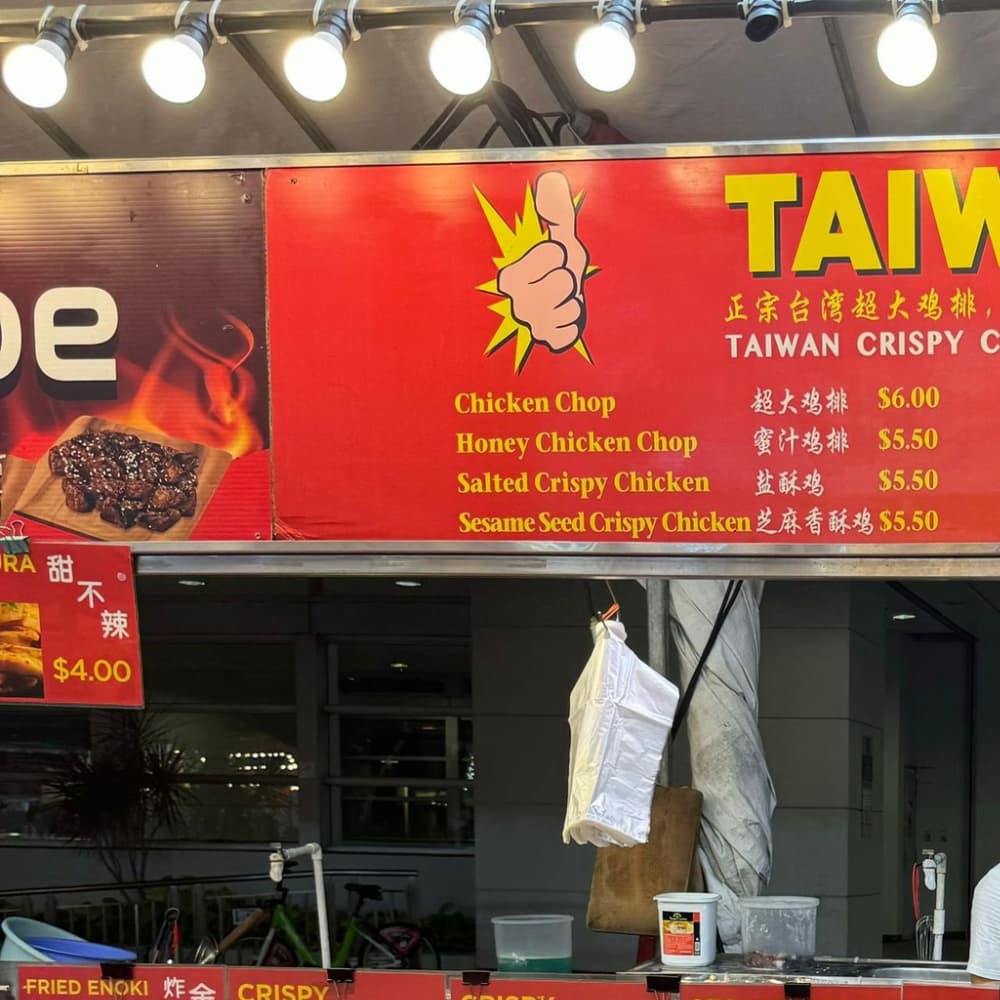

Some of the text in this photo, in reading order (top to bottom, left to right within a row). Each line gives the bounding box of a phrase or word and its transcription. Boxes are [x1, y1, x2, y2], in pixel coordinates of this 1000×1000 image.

[0, 286, 119, 381] e
[724, 332, 840, 359] TAIWAN
[856, 330, 964, 357] CRISPY
[454, 391, 616, 418] Chicken Chop
[750, 386, 849, 415] 超大鸡排
[877, 386, 941, 409] $6.00
[456, 430, 698, 459] Honey Chicken Chop
[753, 426, 850, 457] 蜜汁鸡排
[878, 427, 940, 450] $5.50
[457, 470, 711, 499] Salted Crispy Chicken
[754, 468, 825, 497] 盐酥鸡
[878, 468, 940, 491] $5.50
[458, 510, 752, 539] Sesame Seed Crispy Chicken
[755, 506, 874, 536] 芝麻香酥鸡
[879, 509, 940, 532] $5.50
[0, 553, 37, 573] RA
[52, 657, 132, 684] $4.00
[26, 978, 149, 997] FRIED ENOKI
